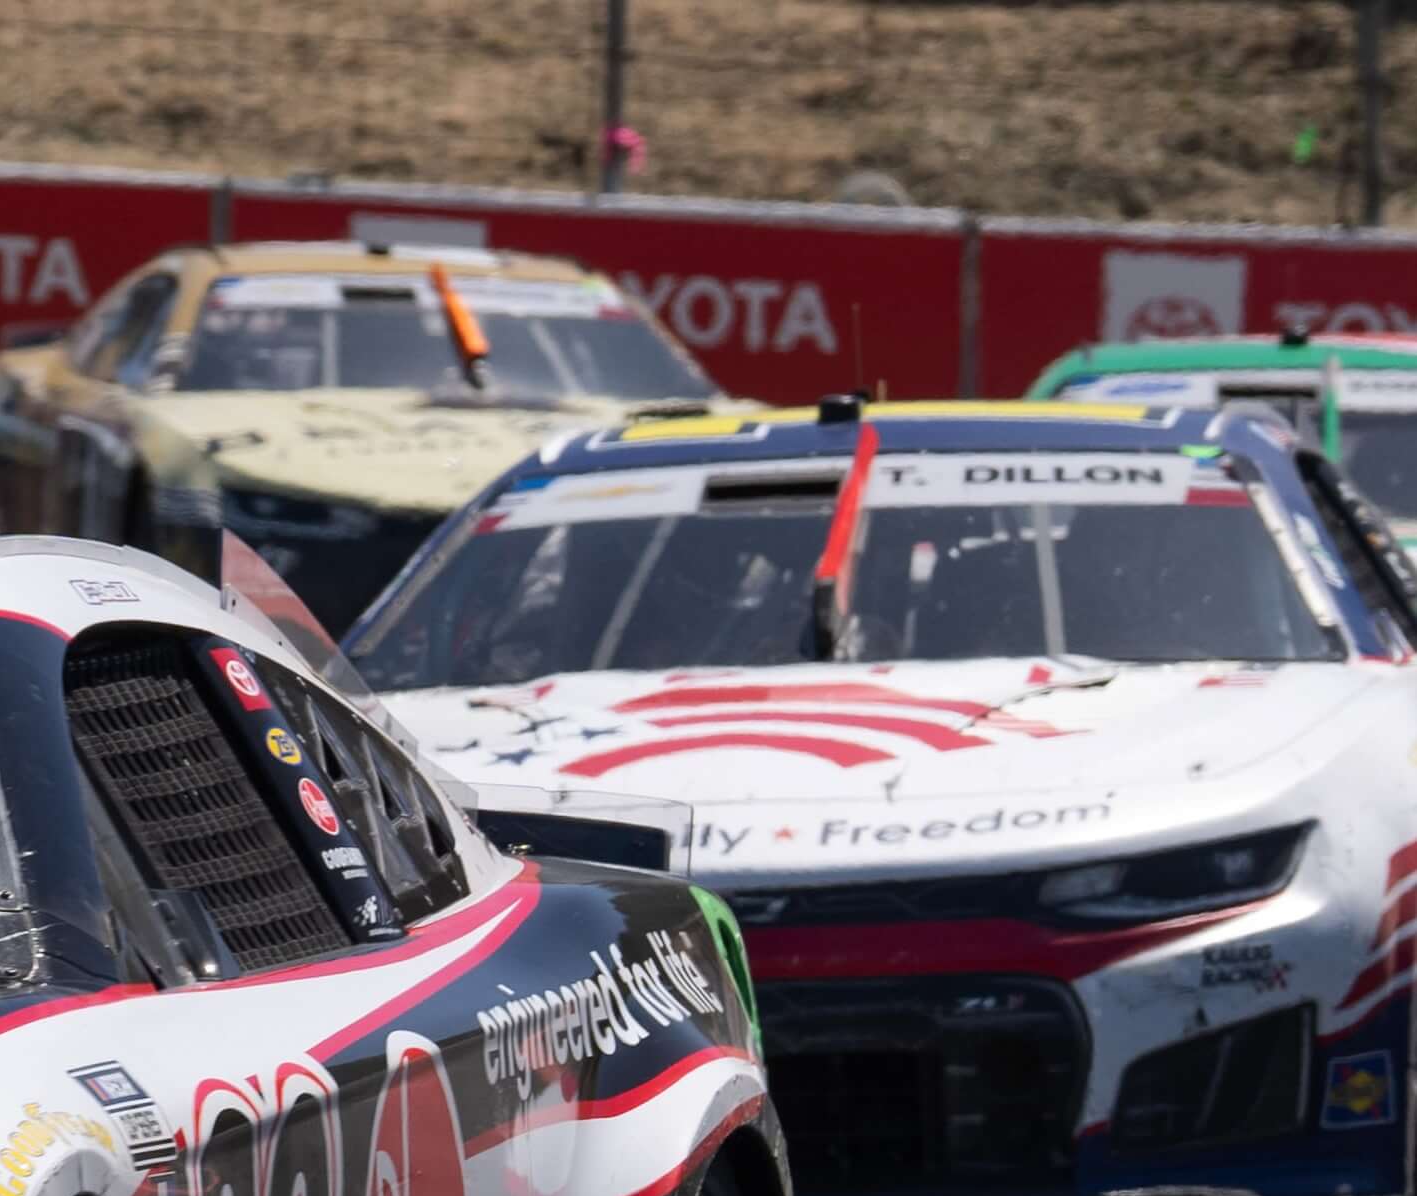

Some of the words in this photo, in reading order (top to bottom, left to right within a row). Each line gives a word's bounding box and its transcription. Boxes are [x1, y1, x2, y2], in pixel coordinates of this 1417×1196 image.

[964, 466, 1164, 484] DILLON
[819, 802, 1115, 847] Freedom
[477, 949, 650, 1101] engineered
[609, 943, 692, 1027] for
